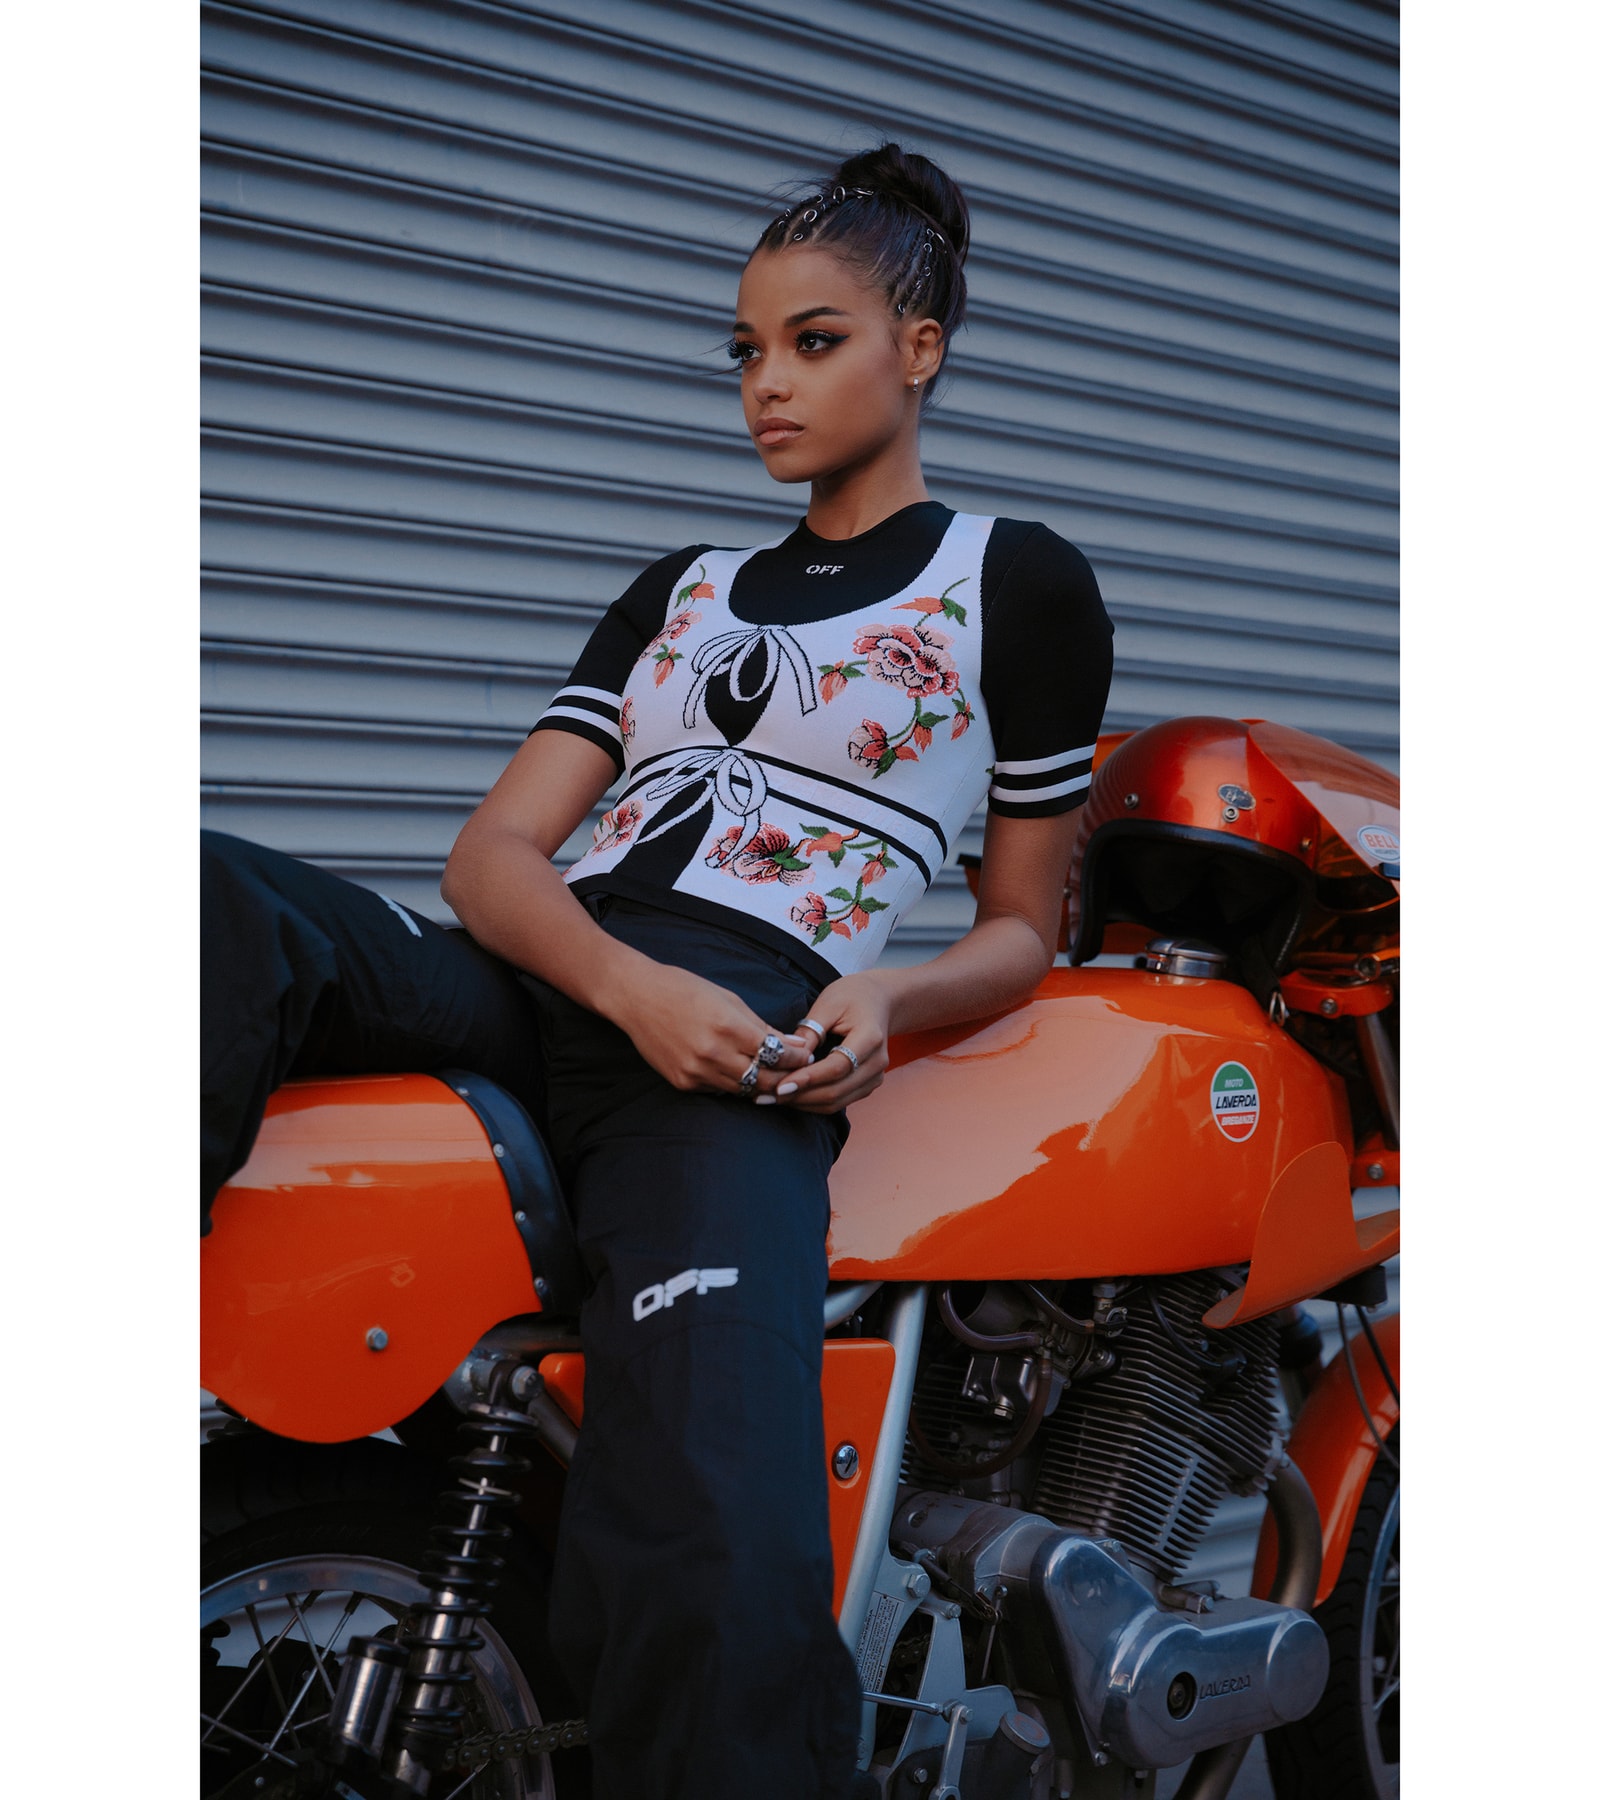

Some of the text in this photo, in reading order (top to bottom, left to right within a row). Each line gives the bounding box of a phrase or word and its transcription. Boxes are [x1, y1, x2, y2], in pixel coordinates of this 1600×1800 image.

[805, 564, 844, 575] OFF
[1364, 834, 1399, 849] BELL
[1224, 1078, 1244, 1088] MOTO
[1215, 1094, 1257, 1109] LAVERDA
[632, 1267, 739, 1322] OFF
